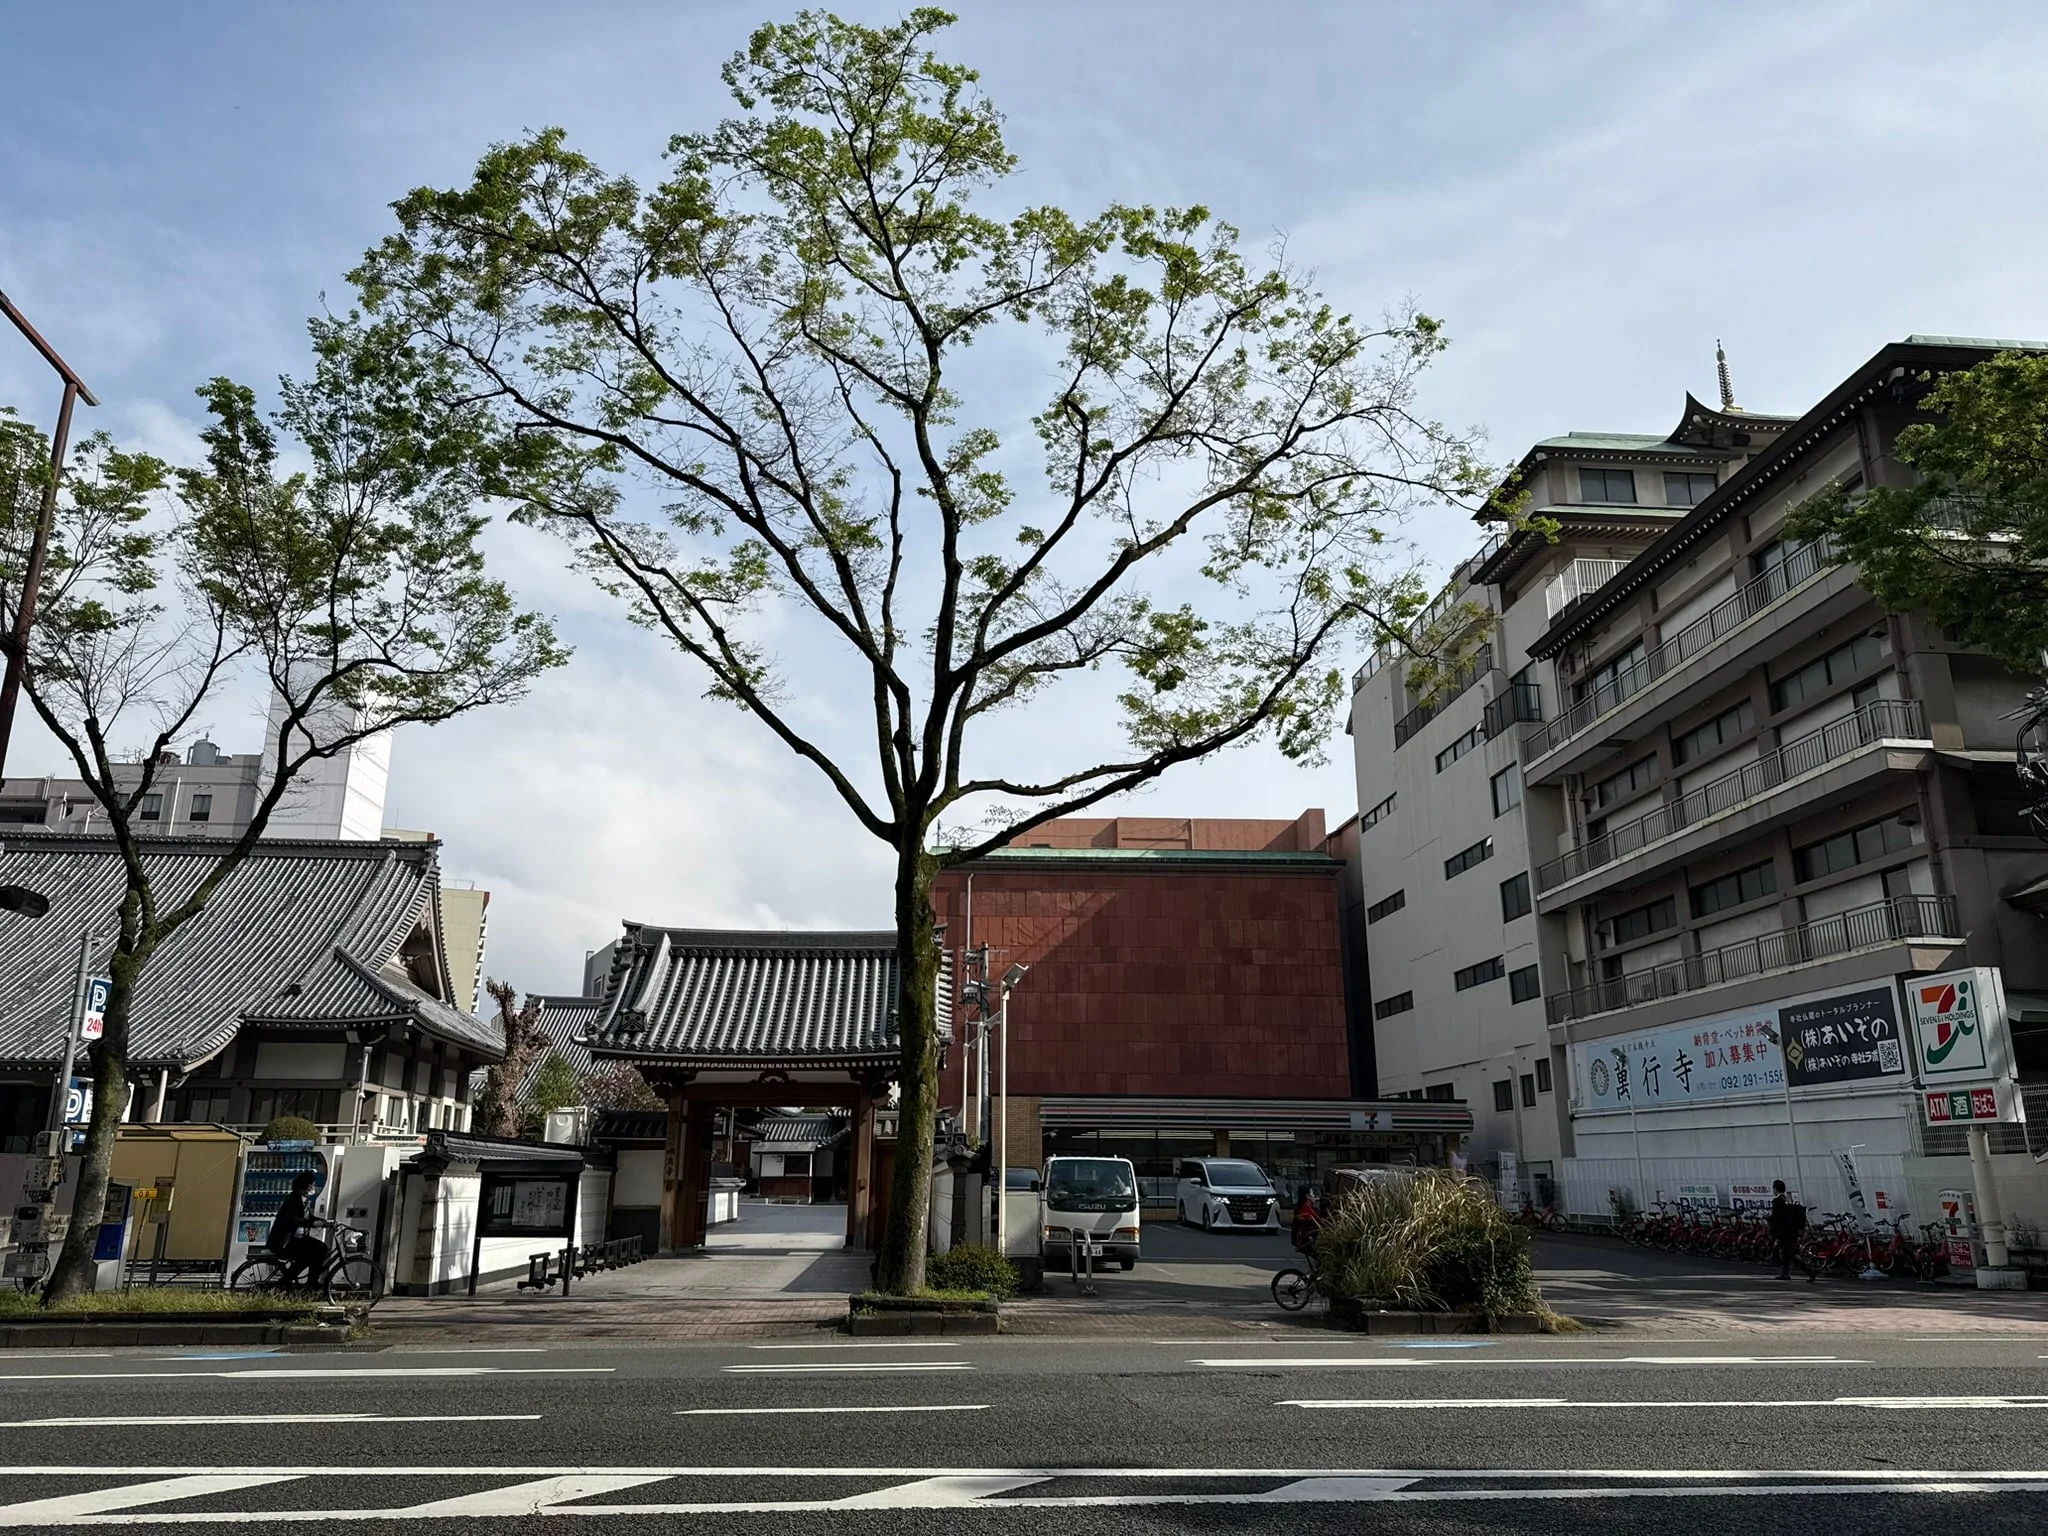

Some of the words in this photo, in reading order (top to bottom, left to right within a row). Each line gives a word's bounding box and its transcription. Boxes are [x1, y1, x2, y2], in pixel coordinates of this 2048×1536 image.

[91, 984, 107, 1012] P
[1944, 1010, 1974, 1022] HOLDINGS
[1800, 1015, 1889, 1048] (株)あいぞの
[1705, 1041, 1768, 1068] 加入募集中
[1614, 1049, 1694, 1101] 萬行寺
[1929, 1097, 1950, 1117] ATM
[1953, 1096, 1969, 1116] 酒
[1973, 1094, 1996, 1114] たばこ
